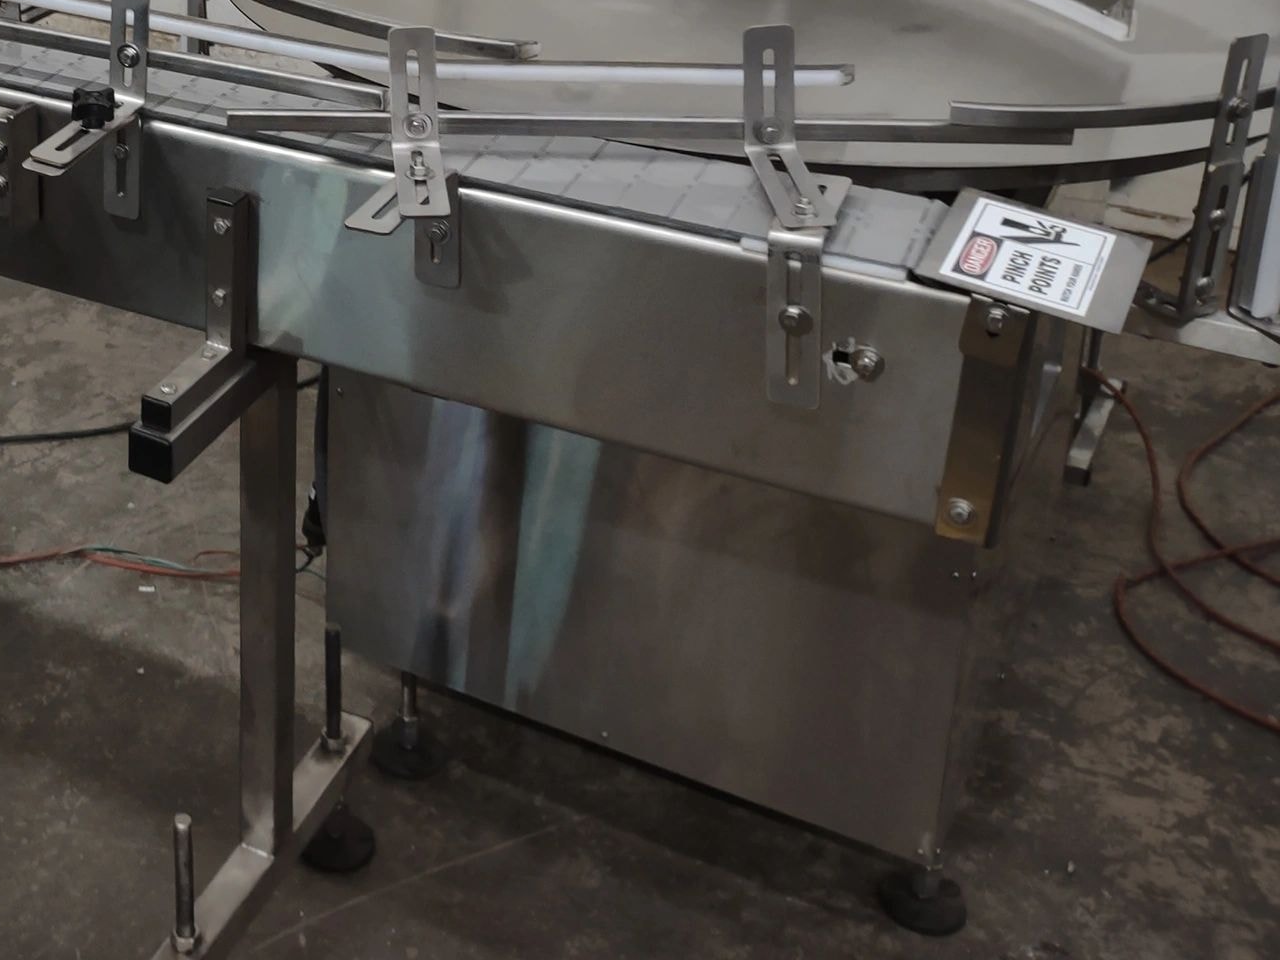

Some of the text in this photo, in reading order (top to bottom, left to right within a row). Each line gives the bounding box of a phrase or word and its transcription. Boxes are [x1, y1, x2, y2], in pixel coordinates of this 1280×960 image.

[962, 237, 993, 272] DANGER
[1002, 249, 1033, 284] PINCH
[1028, 255, 1062, 295] POINTS
